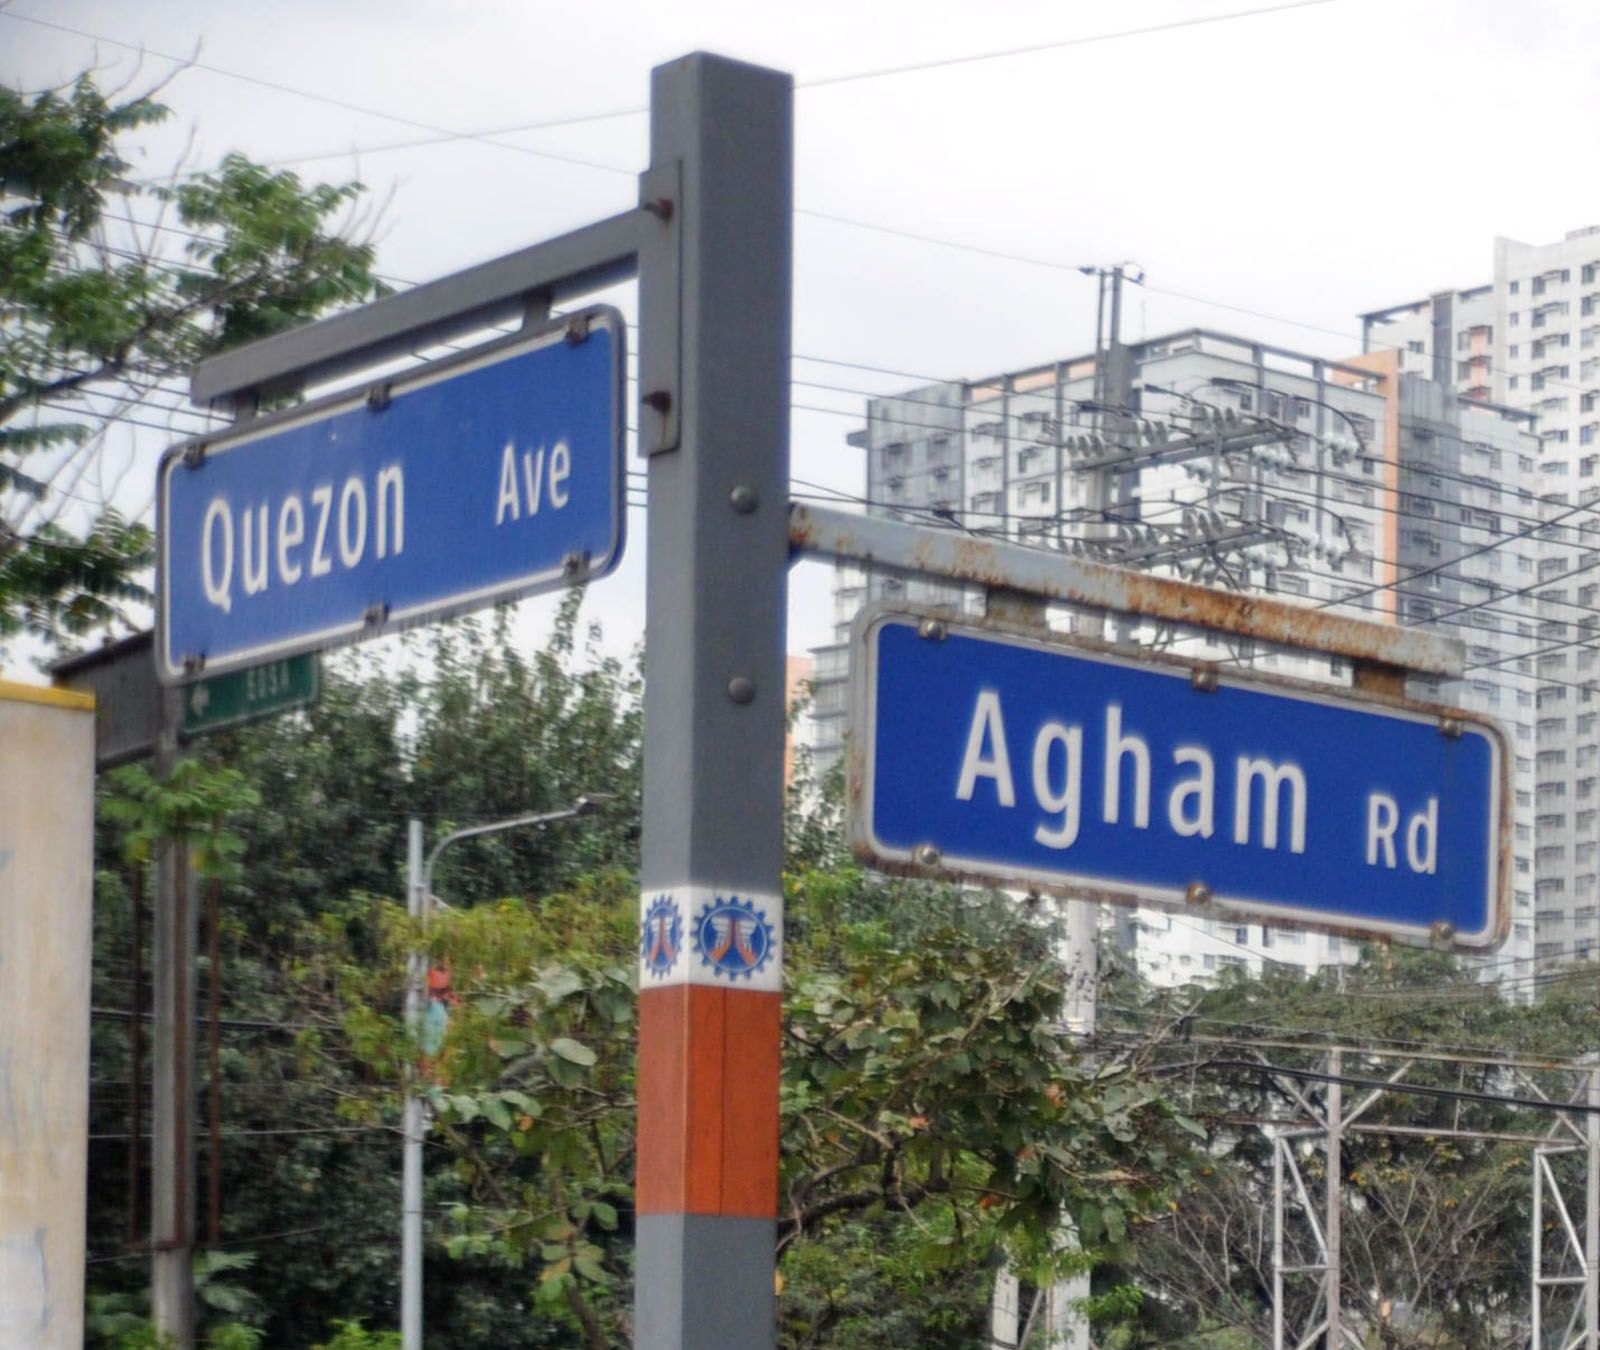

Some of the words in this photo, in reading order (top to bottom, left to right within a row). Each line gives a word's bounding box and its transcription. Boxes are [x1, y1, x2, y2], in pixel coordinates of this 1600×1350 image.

[203, 463, 404, 614] Quezon
[496, 442, 571, 526] Ave
[955, 690, 1307, 855] Agham
[1366, 794, 1438, 875] Rd
